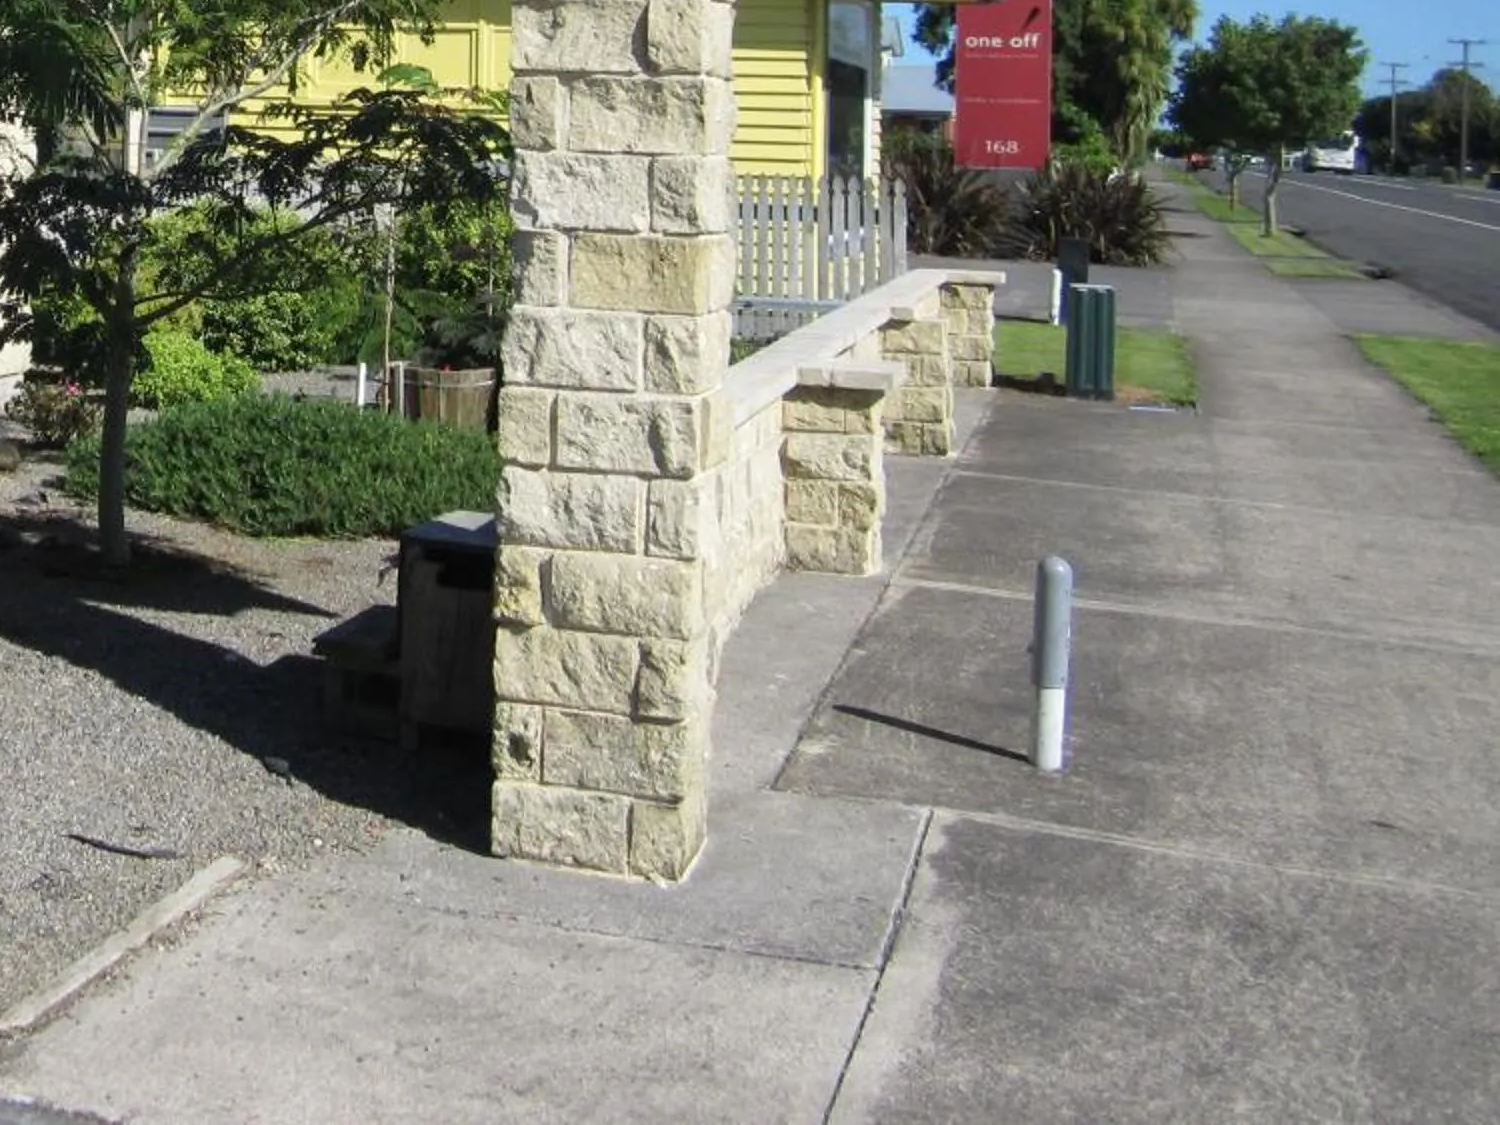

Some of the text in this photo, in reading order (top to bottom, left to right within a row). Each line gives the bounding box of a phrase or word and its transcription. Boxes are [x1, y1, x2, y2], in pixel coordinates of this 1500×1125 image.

[965, 32, 1040, 48] one off
[984, 140, 1019, 154] 168
